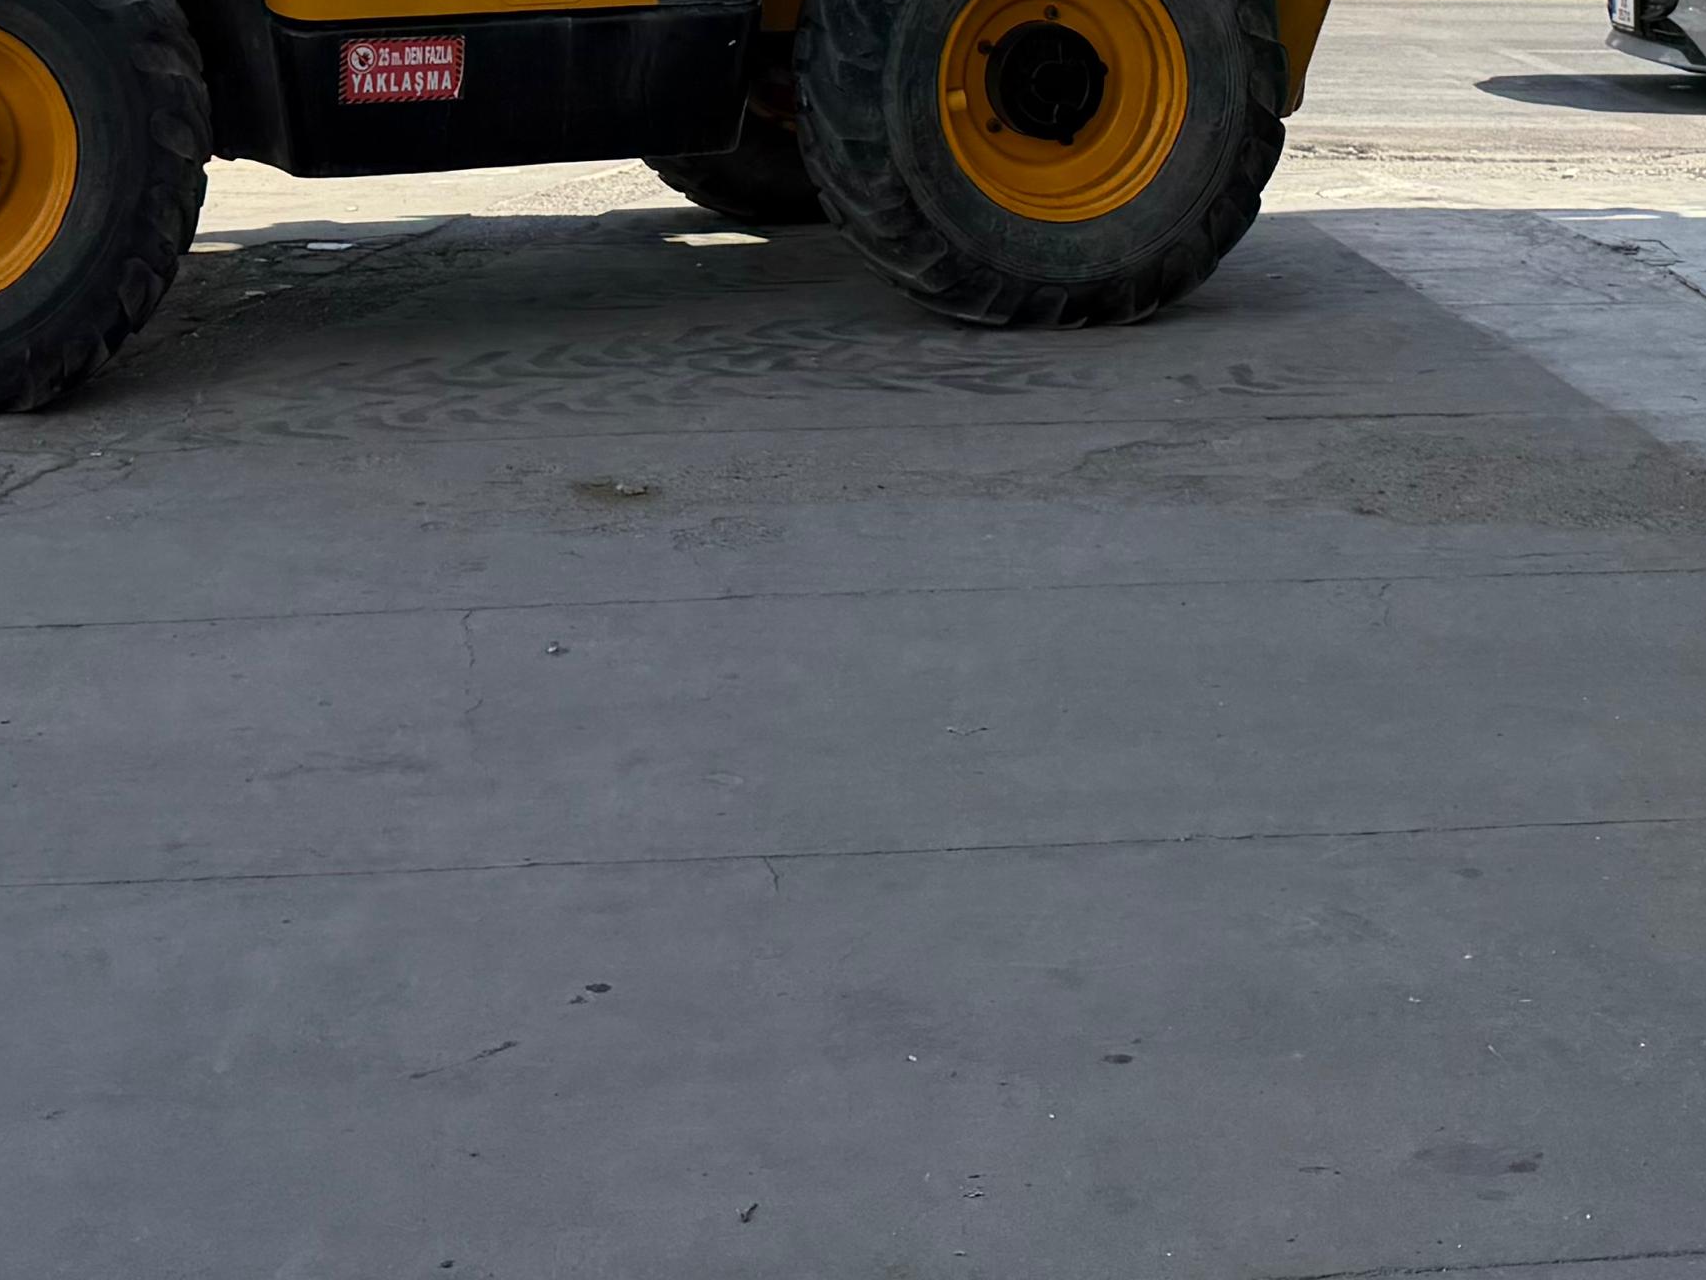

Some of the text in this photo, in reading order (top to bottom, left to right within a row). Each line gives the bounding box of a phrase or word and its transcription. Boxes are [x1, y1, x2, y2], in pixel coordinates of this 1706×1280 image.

[378, 47, 390, 66] 25
[404, 46, 424, 66] DEN
[424, 45, 453, 65] FAZLA
[351, 70, 453, 96] YAKLAŞMA
